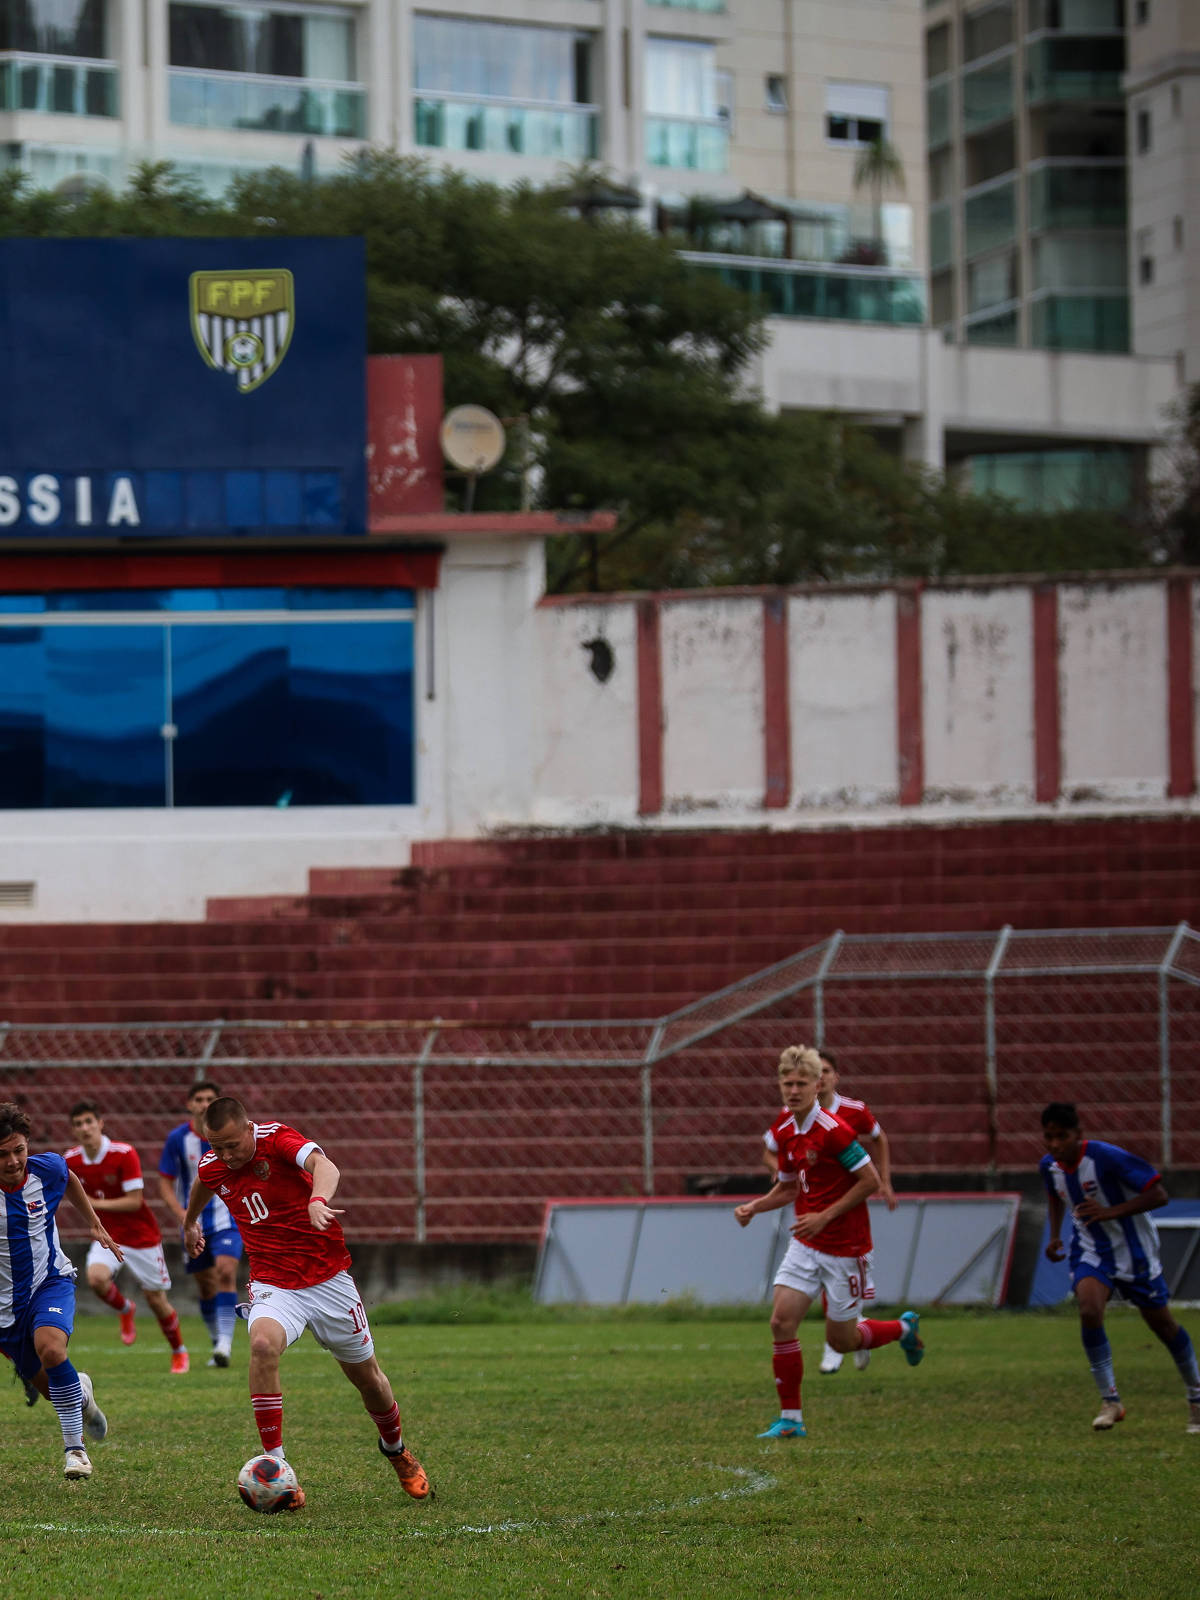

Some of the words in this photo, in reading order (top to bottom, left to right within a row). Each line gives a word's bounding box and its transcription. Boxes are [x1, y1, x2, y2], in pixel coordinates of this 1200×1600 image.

[206, 280, 276, 307] FPF
[800, 1168, 809, 1194] 8
[241, 1191, 270, 1225] 10
[848, 1275, 859, 1298] 8
[348, 1302, 368, 1335] 10
